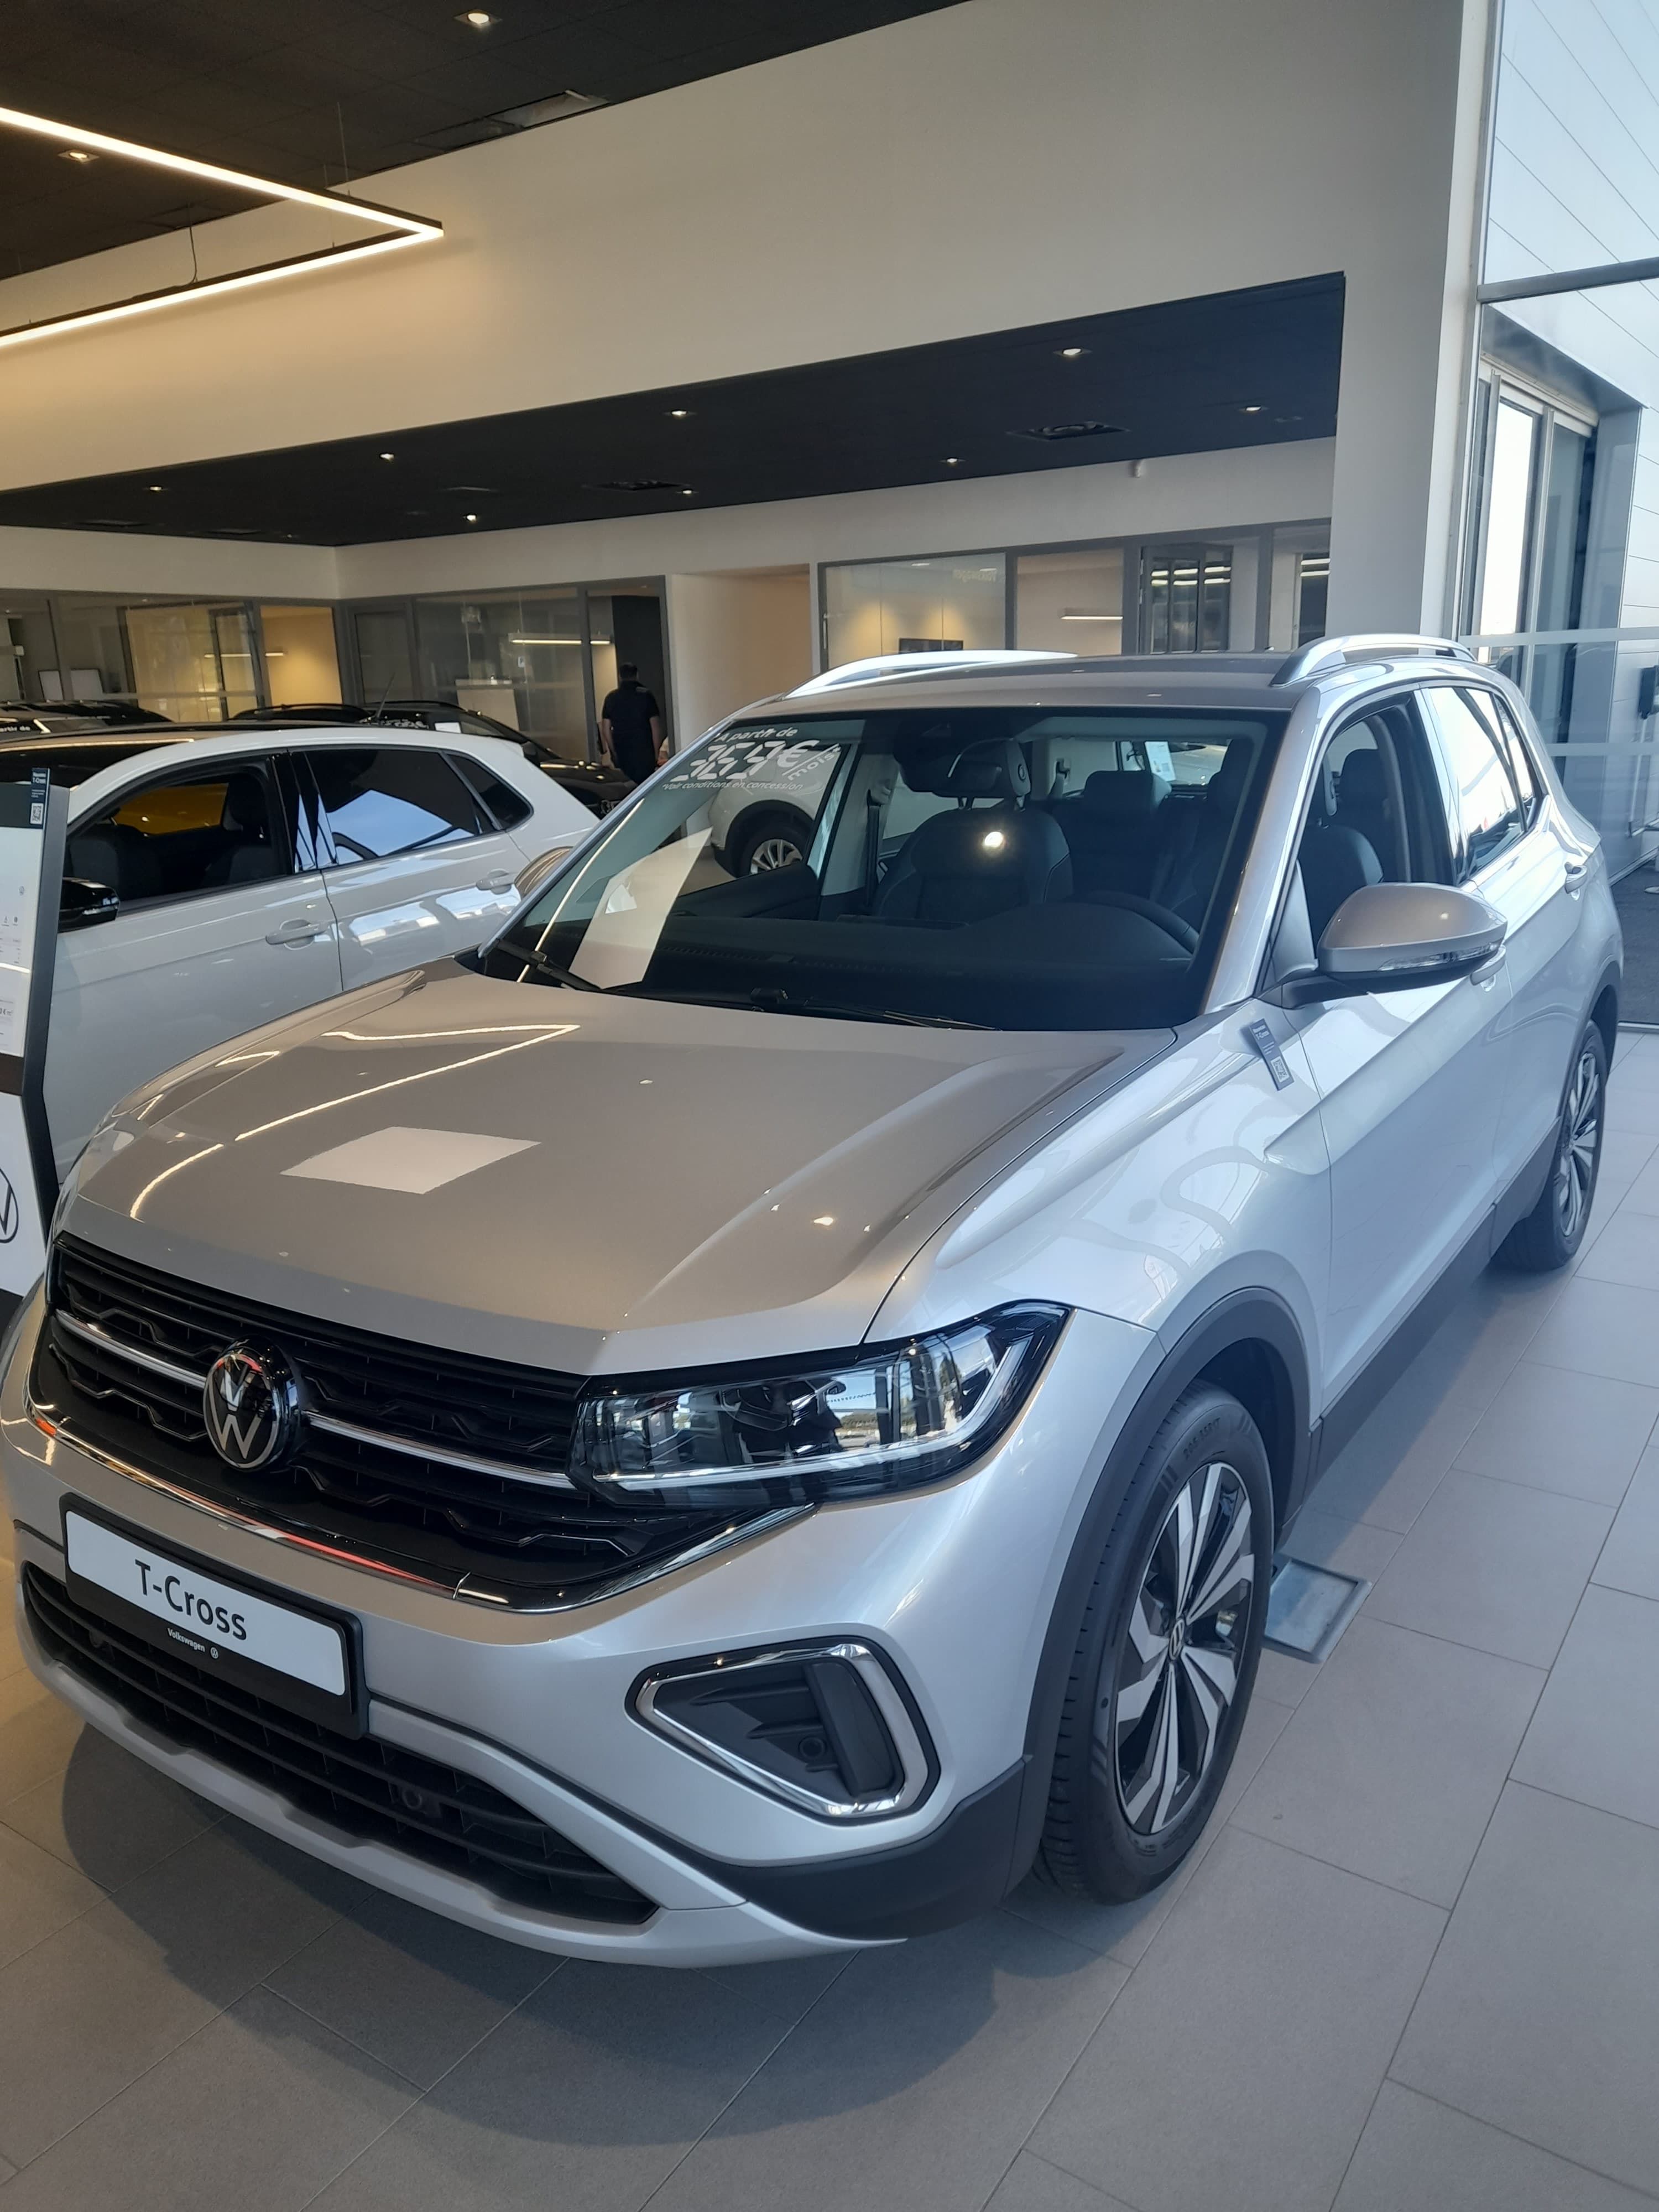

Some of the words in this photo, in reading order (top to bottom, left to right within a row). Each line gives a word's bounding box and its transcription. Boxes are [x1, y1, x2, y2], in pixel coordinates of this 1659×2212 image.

[776, 727, 798, 737] de
[682, 780, 731, 789] conditions
[745, 781, 804, 790] concession
[135, 1559, 247, 1641] T-Cross
[167, 1627, 205, 1652] Volkswagen
